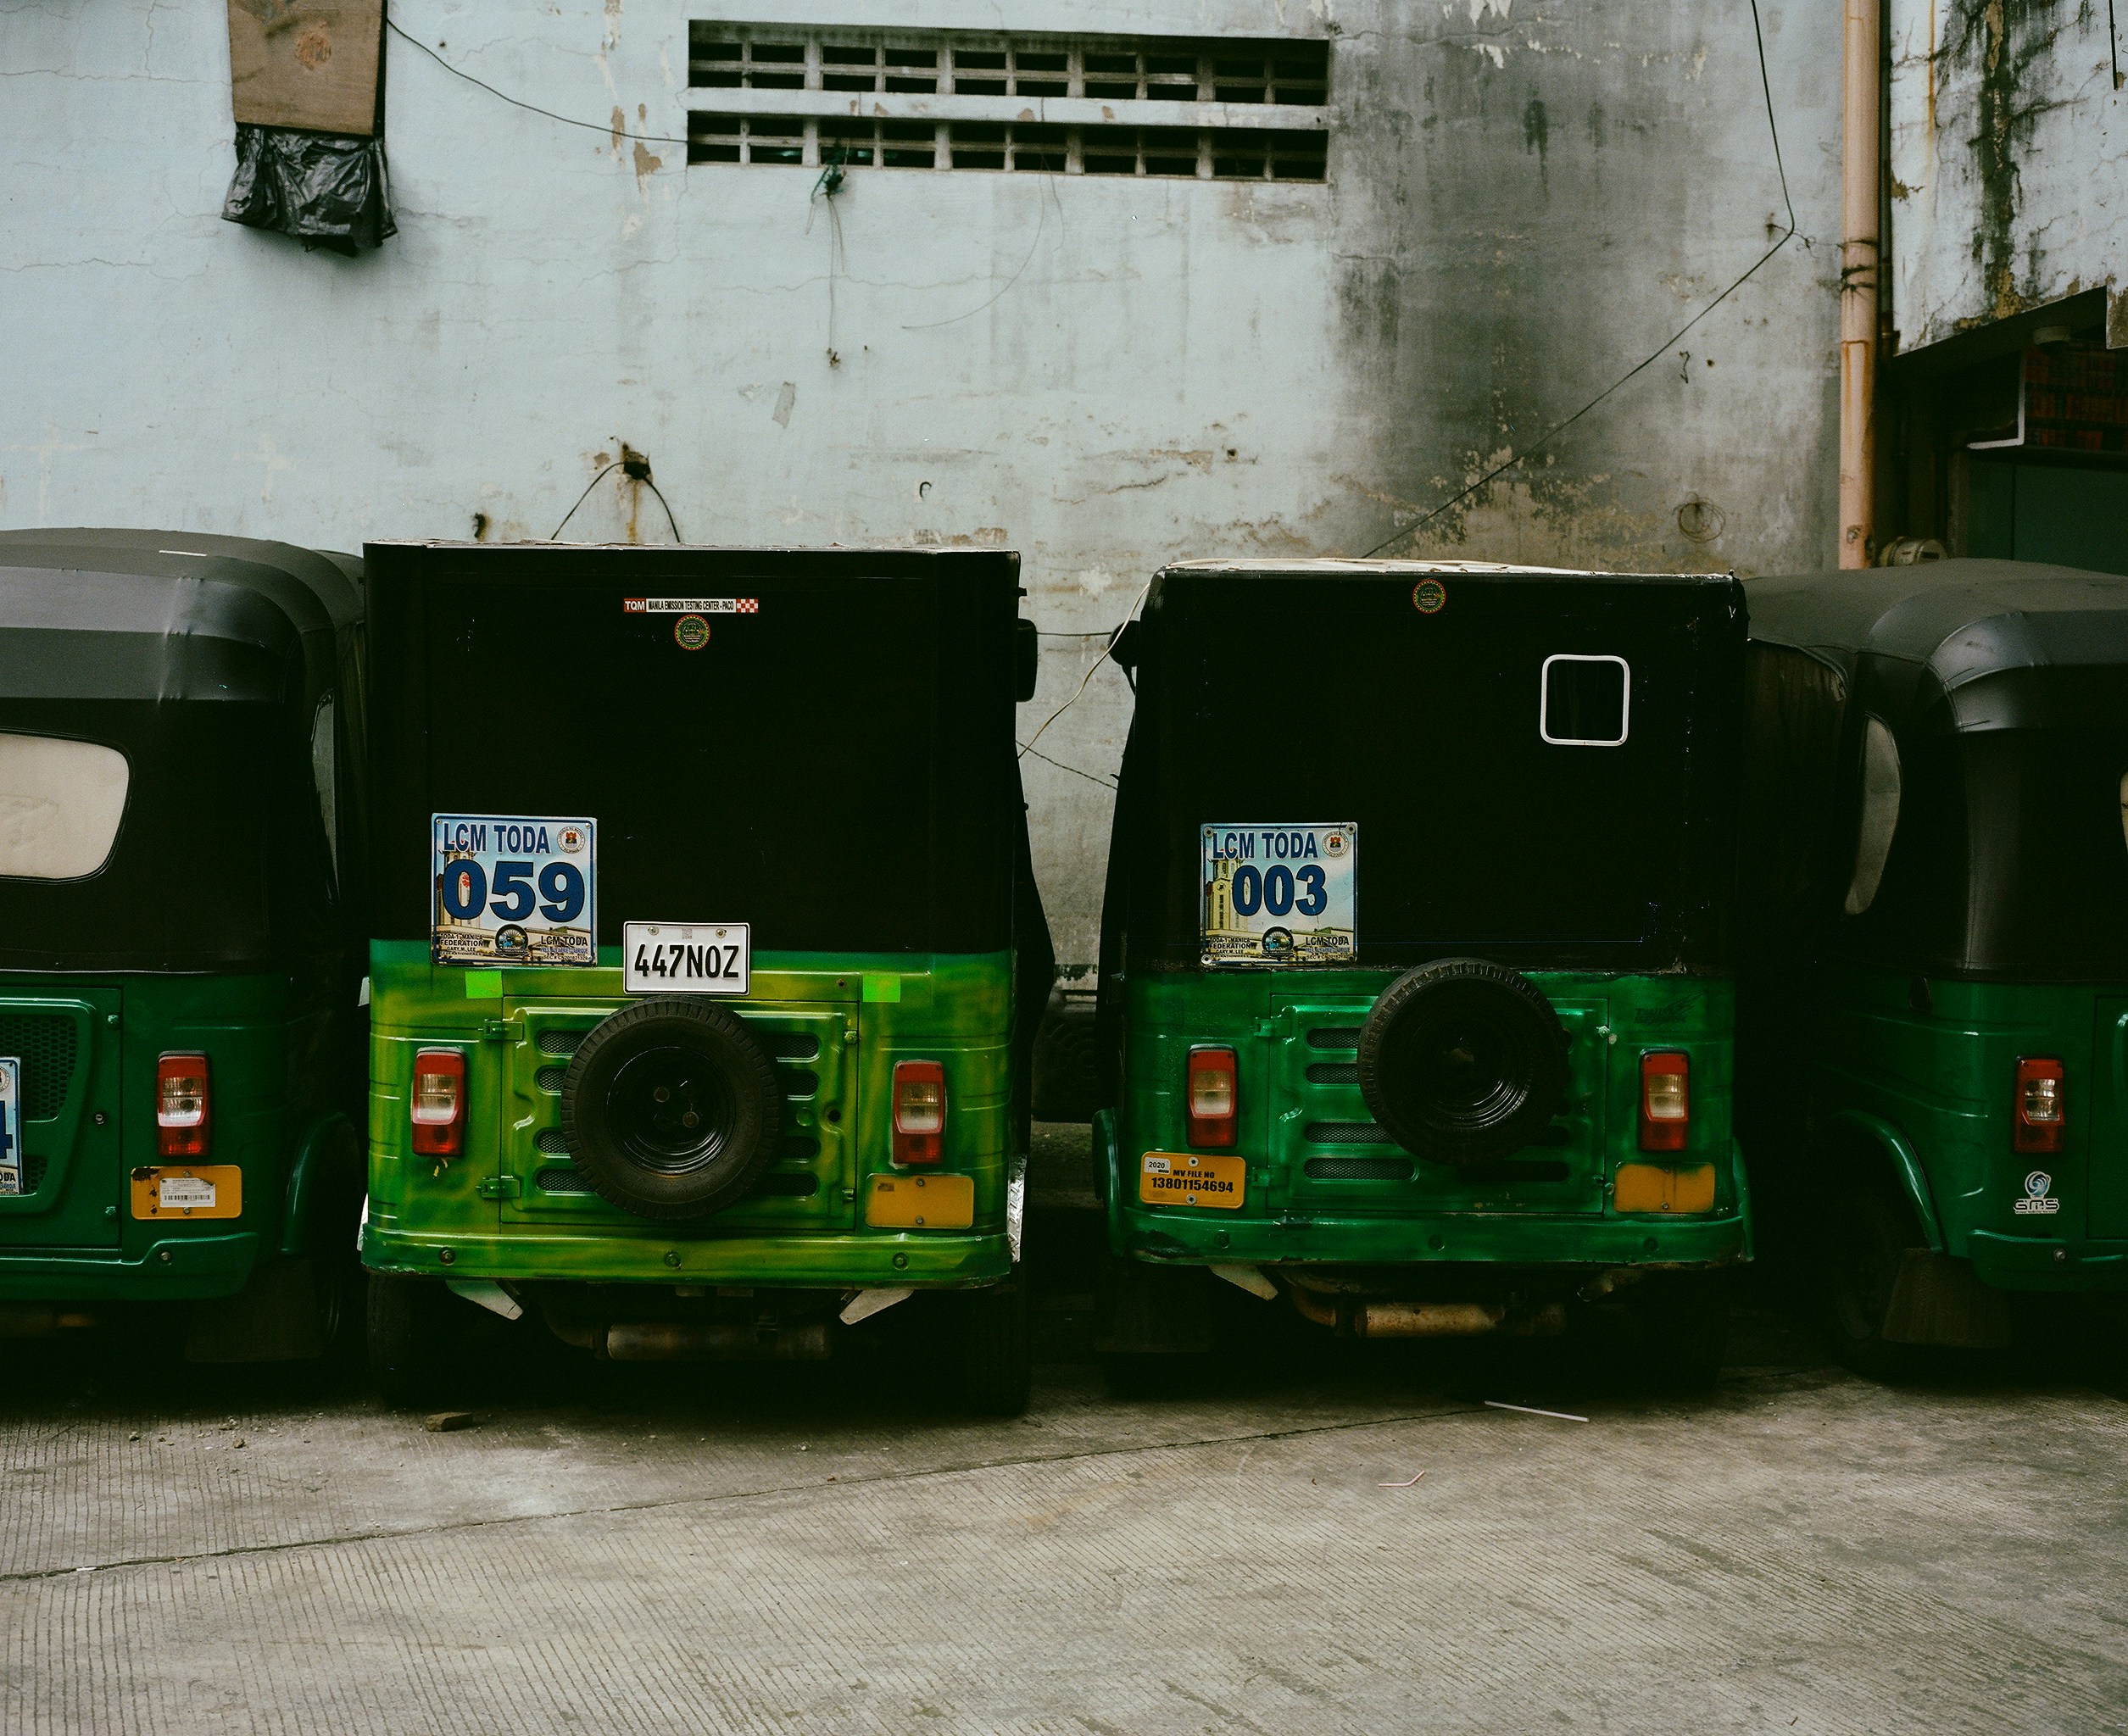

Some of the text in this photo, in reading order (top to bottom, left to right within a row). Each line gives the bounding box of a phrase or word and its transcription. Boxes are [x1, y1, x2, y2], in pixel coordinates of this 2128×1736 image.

[624, 600, 645, 611] TQM
[648, 600, 665, 610] MANILA
[685, 600, 703, 610] TESTING
[703, 600, 720, 610] CENTER
[722, 600, 734, 610] PACO
[443, 822, 487, 852] LCM
[493, 824, 551, 854] TODA
[1212, 831, 1255, 860] LCM
[1262, 831, 1318, 860] TODA
[443, 859, 585, 923] 059
[1232, 864, 1329, 917] 003
[541, 935, 588, 946] LCM TODA
[1306, 936, 1350, 946] LCM TODA
[634, 943, 739, 979] 447NOZ
[1151, 1177, 1234, 1193] 13801154694
[1173, 1169, 1185, 1177] MV
[1187, 1170, 1202, 1178] FILE
[1204, 1171, 1215, 1179] NO
